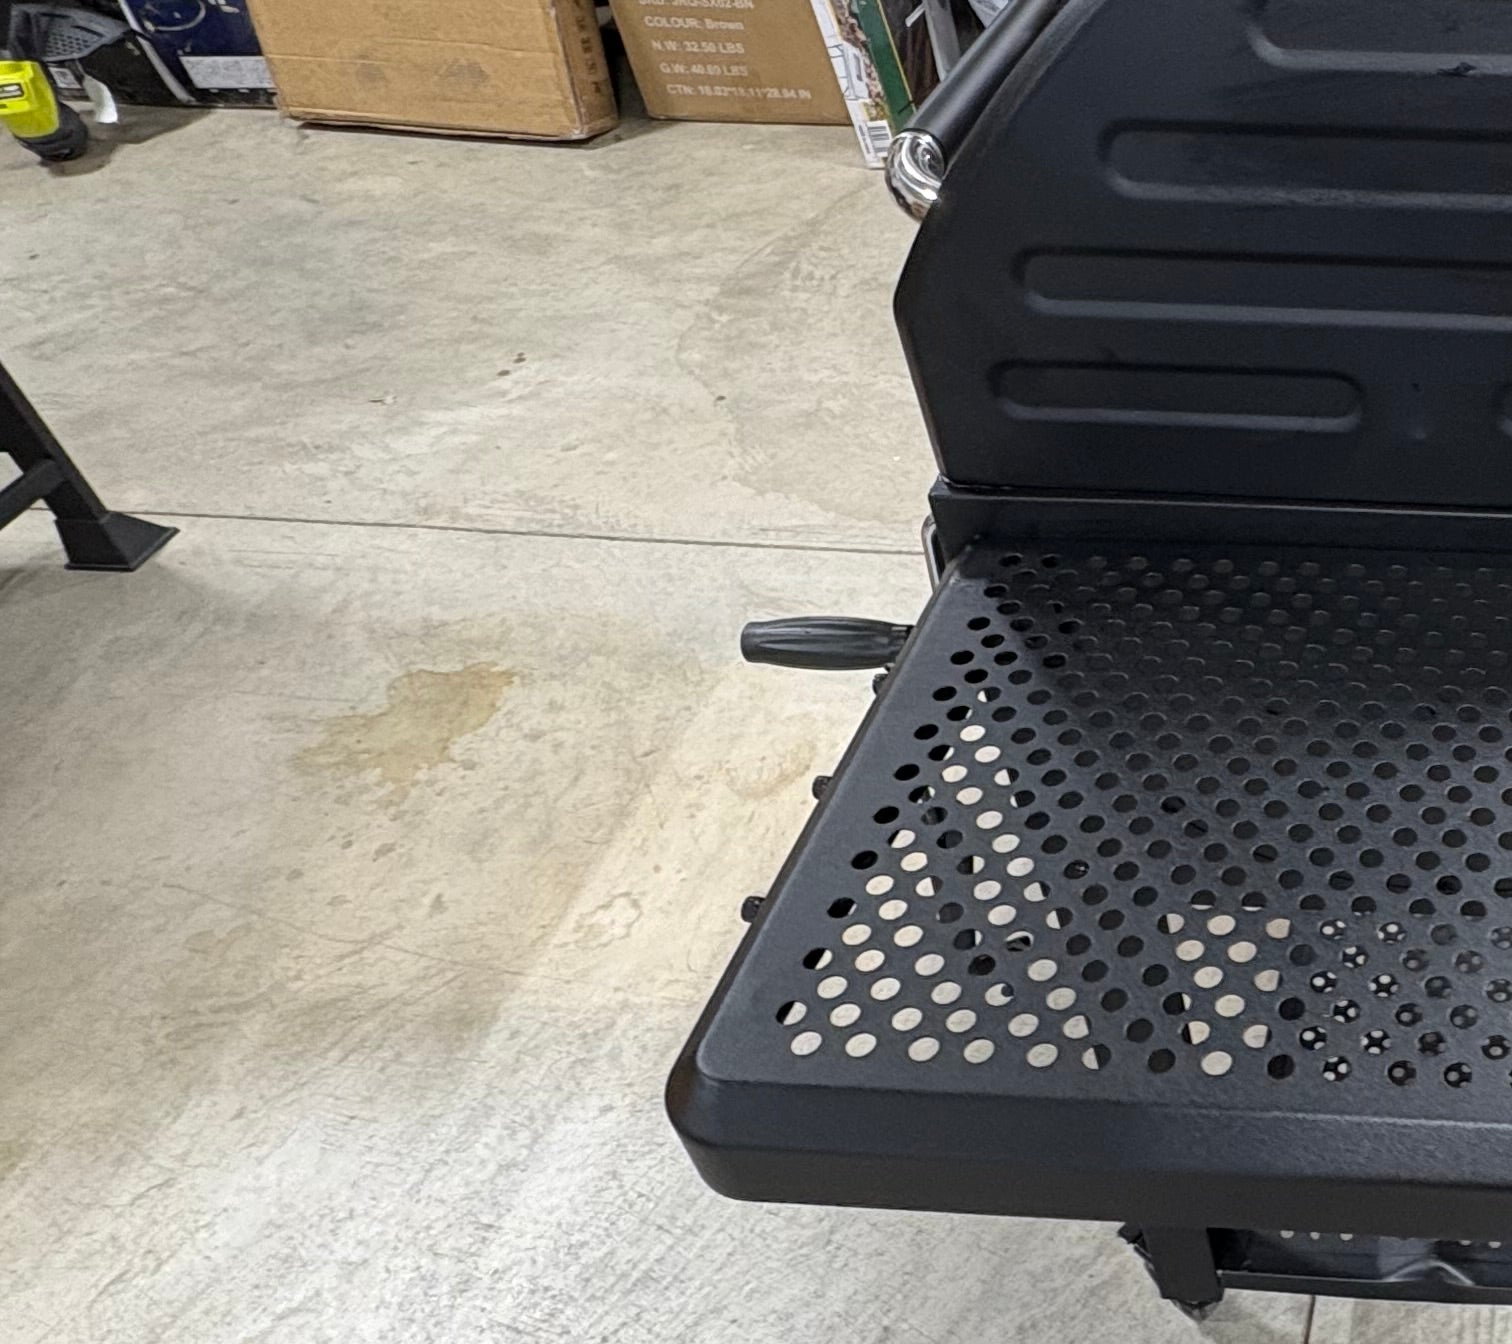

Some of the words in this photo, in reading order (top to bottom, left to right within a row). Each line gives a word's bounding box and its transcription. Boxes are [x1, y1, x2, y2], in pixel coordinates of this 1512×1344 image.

[644, 15, 702, 30] COLOUR:
[704, 17, 744, 31] Brown
[719, 42, 744, 55] LBS
[723, 64, 749, 77] LBS
